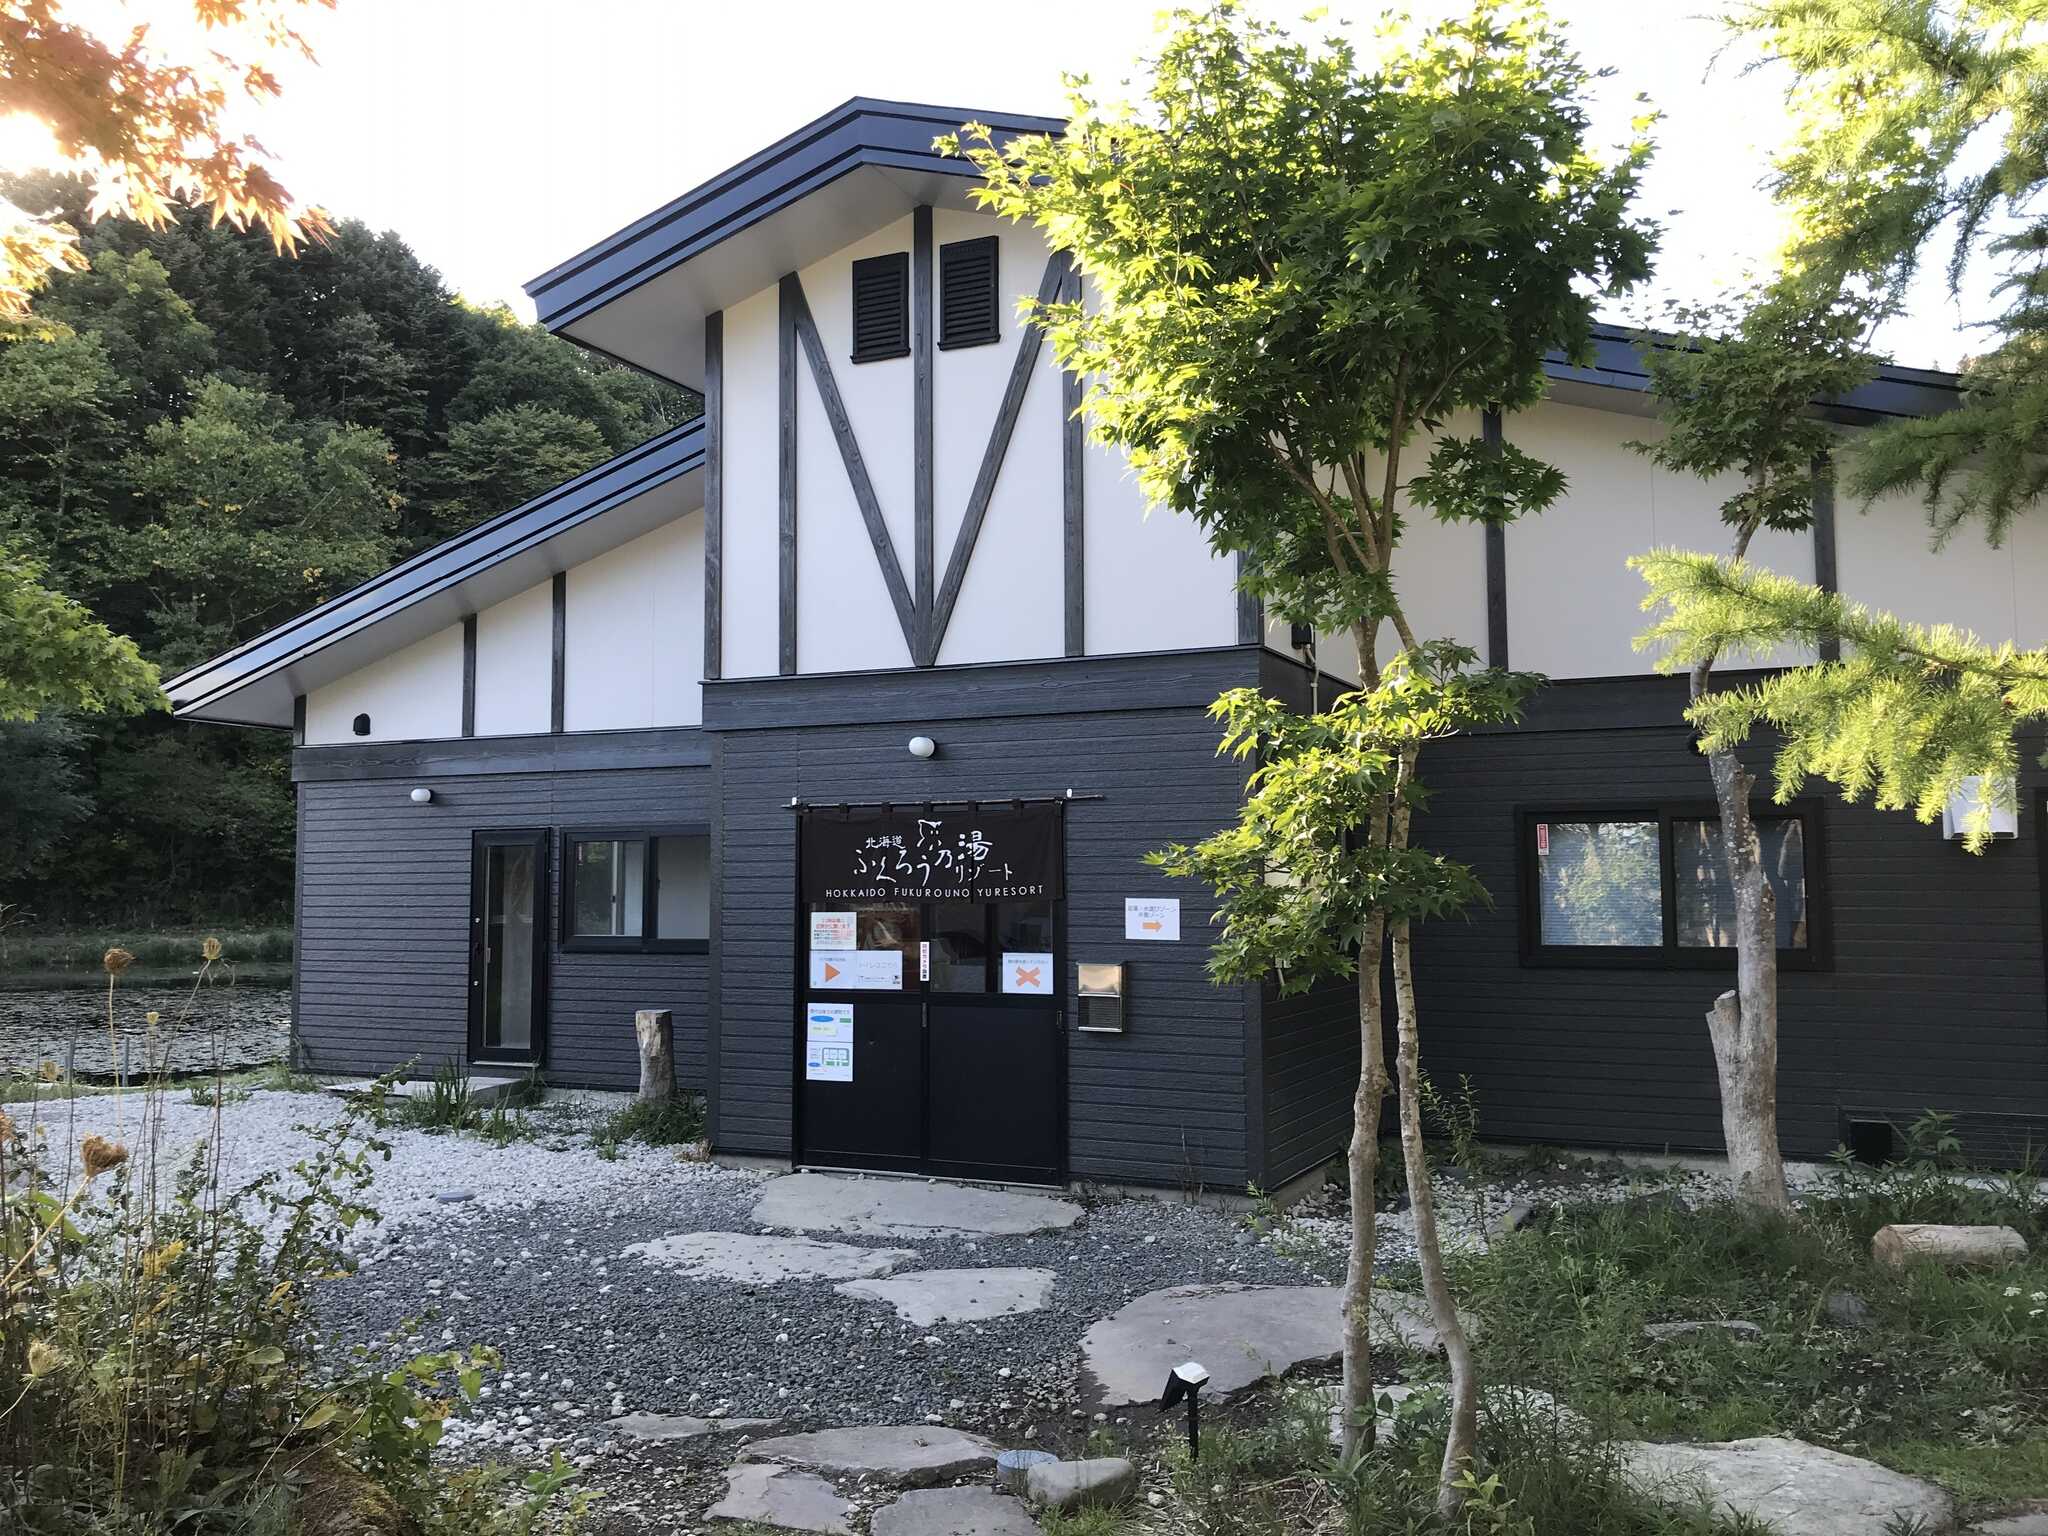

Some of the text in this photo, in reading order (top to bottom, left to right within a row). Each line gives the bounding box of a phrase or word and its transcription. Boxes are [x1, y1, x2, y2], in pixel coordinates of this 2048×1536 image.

[865, 835, 906, 849] 北海道
[955, 863, 1013, 883] リゾート
[825, 887, 886, 898] HOKKAIDO
[894, 887, 970, 898] FUKUROUNO
